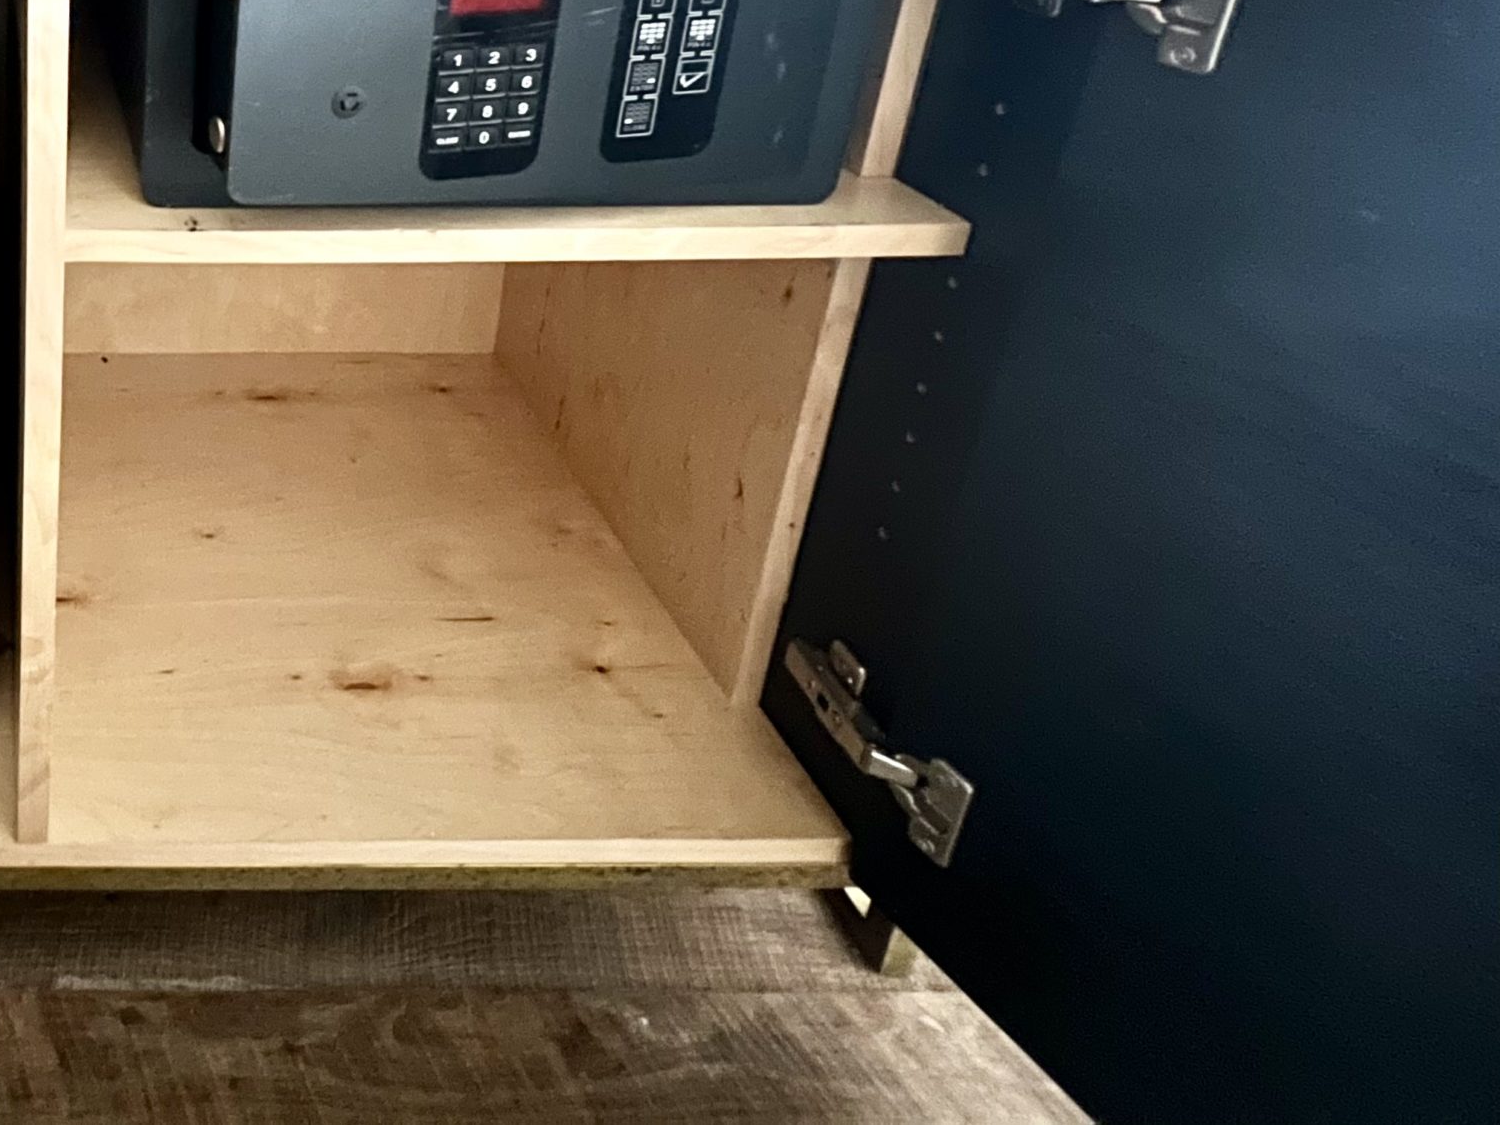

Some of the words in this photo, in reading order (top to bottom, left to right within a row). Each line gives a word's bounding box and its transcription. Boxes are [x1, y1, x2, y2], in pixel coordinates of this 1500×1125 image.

[453, 54, 462, 66] 1
[488, 51, 500, 64] 2
[525, 48, 537, 62] 3
[447, 81, 459, 94] 4
[485, 78, 497, 91] 5
[521, 75, 533, 88] 6
[446, 108, 457, 121] 7
[482, 105, 493, 118] 8
[517, 102, 529, 115] 9
[479, 131, 490, 144] 0
